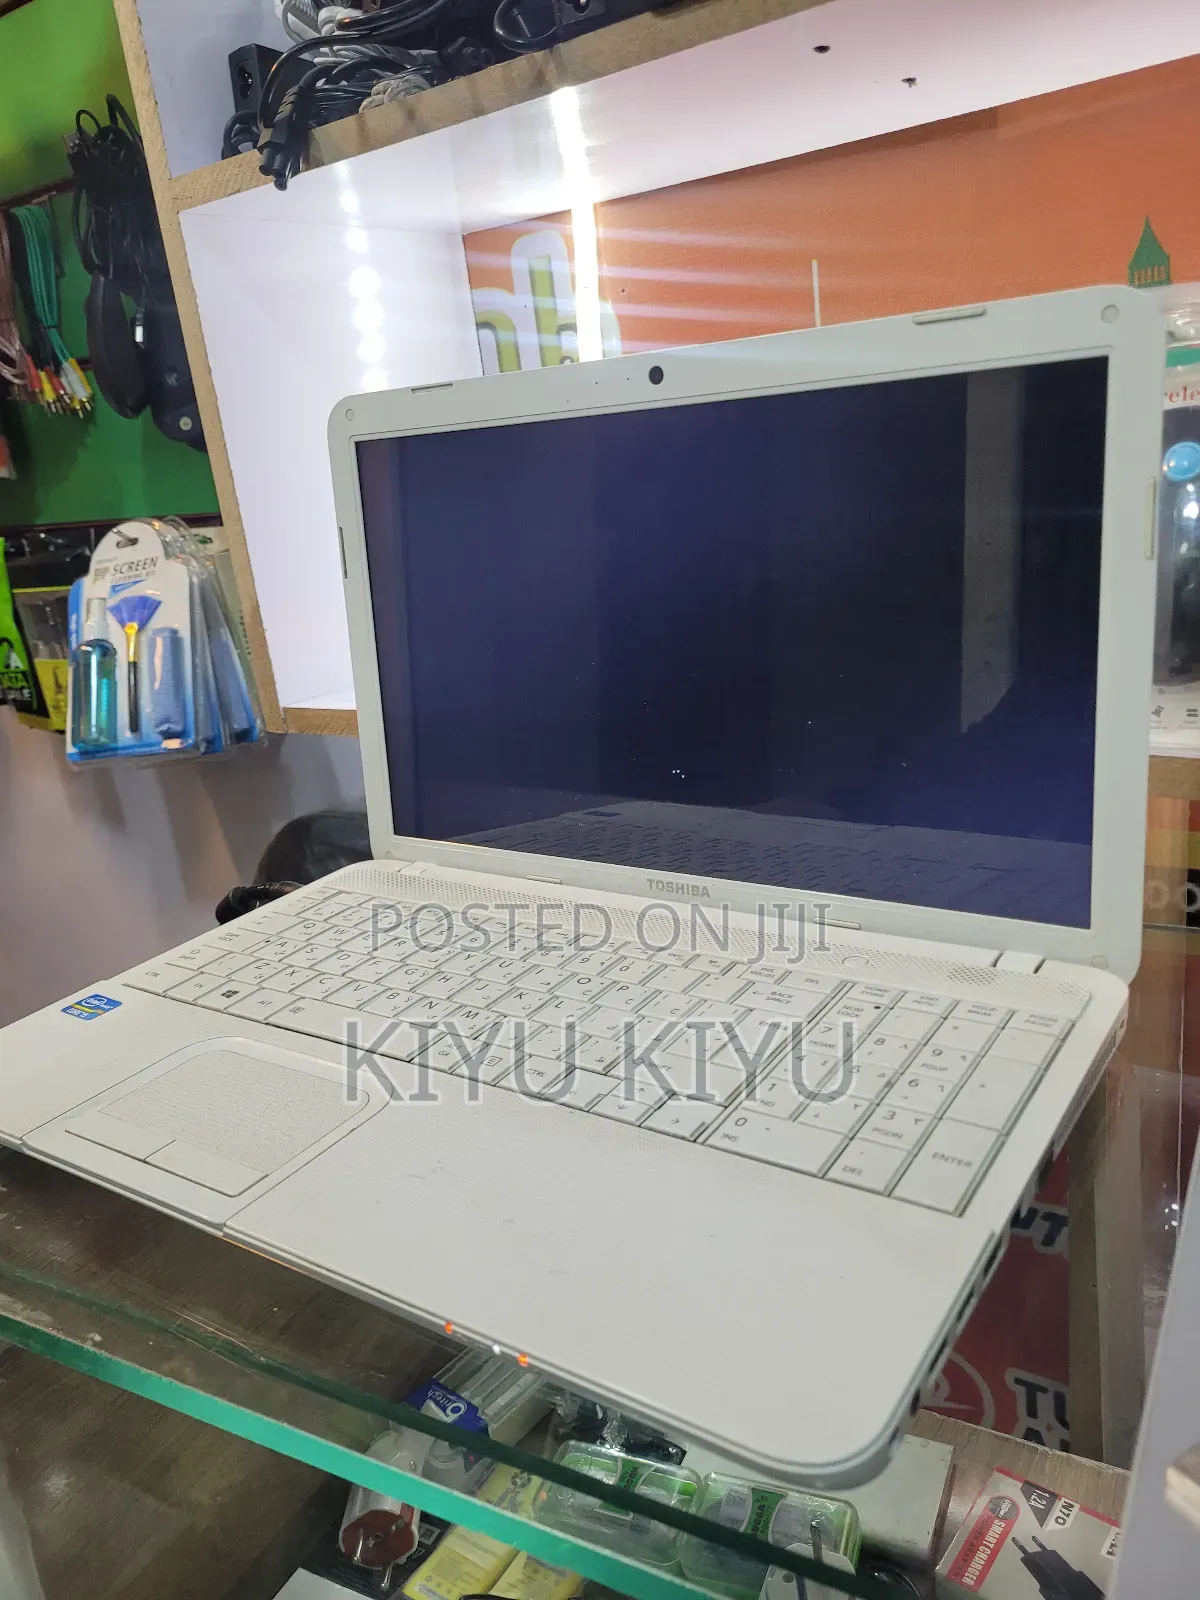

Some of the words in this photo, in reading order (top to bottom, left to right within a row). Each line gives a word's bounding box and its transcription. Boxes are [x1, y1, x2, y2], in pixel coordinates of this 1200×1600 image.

[113, 556, 159, 574] SCREEN
[646, 879, 710, 898] TOSHIBA
[764, 996, 793, 1005] SPACE
[769, 991, 795, 999] BACK
[837, 1010, 861, 1018] LOCK
[842, 1005, 865, 1013] NUM
[526, 1068, 547, 1078] CTRL
[932, 1151, 973, 1168] ENTER
[1028, 1488, 1050, 1510] 1.2A
[983, 1519, 1006, 1549] SMART
[961, 1546, 991, 1586] CHARGER
